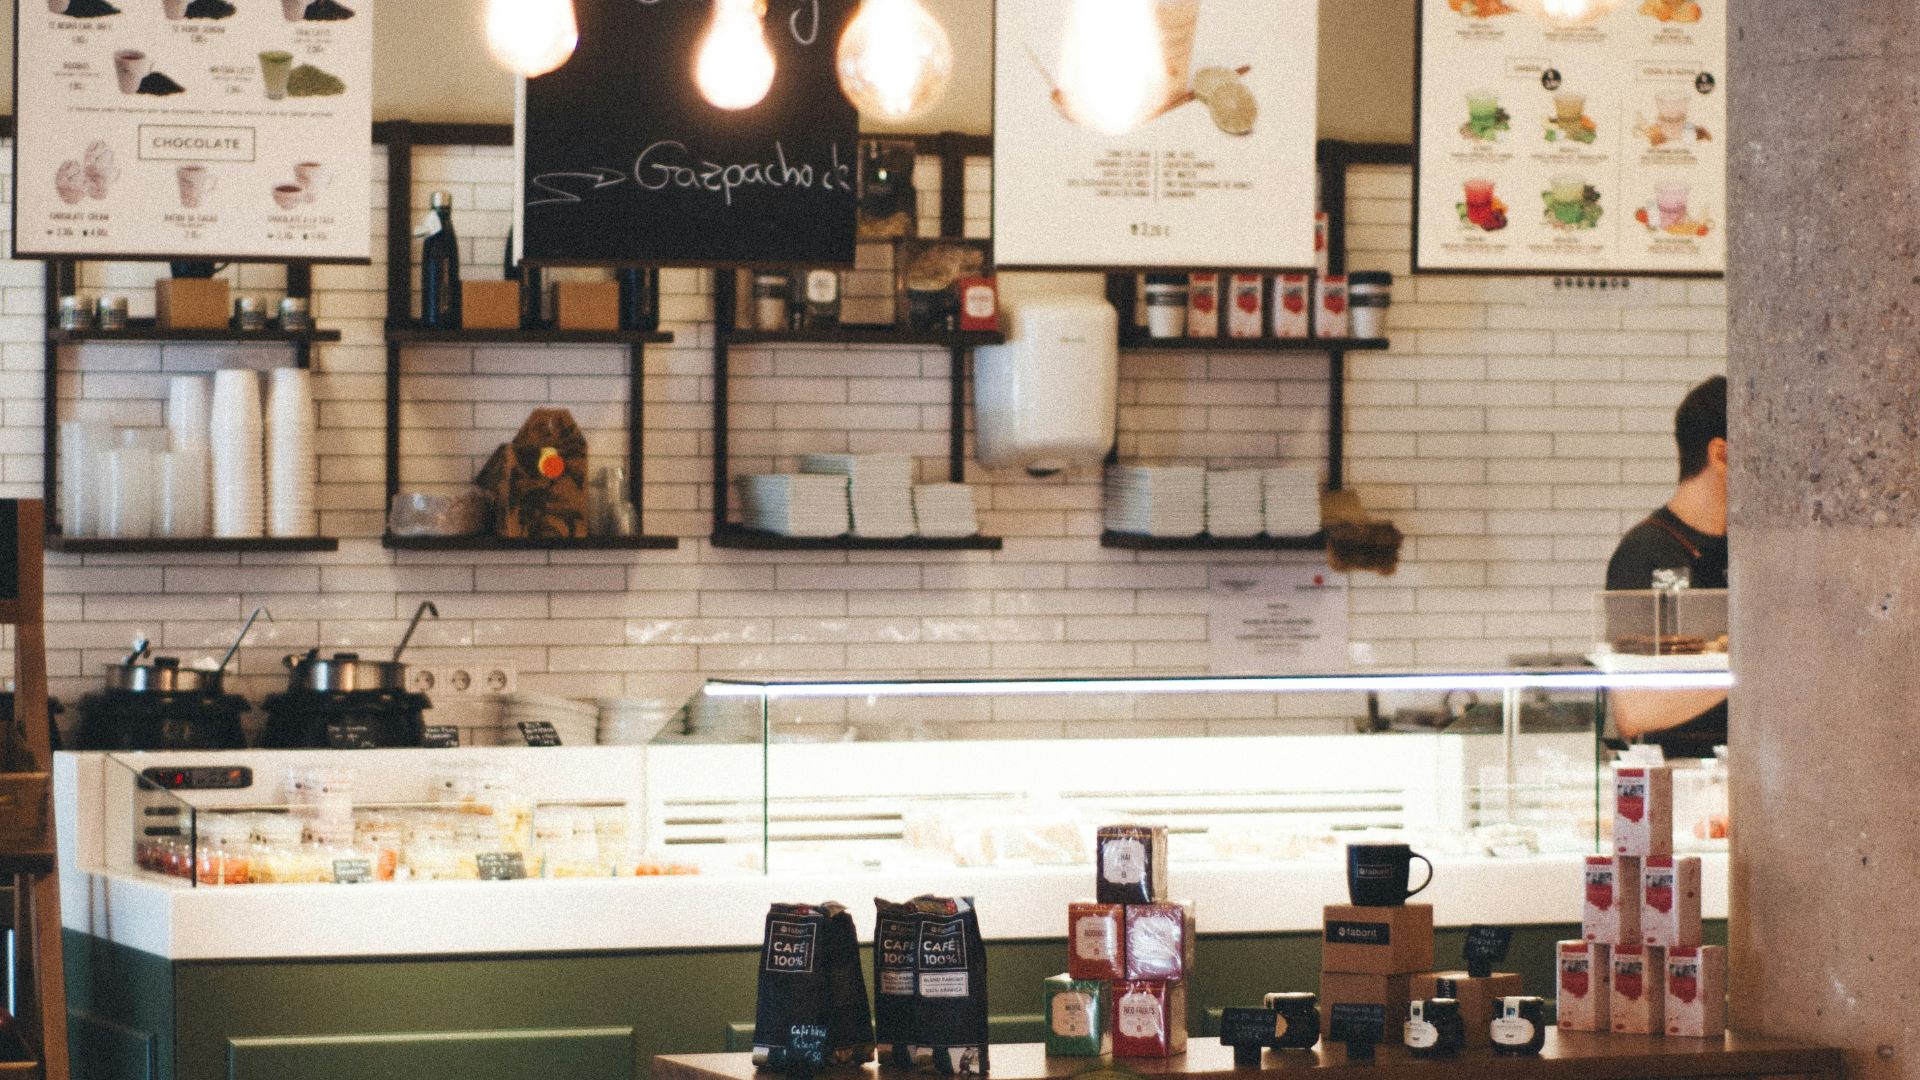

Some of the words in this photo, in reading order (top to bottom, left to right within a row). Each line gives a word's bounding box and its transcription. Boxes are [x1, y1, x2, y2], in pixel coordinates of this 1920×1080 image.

[152, 136, 241, 150] CHOCOLATE
[634, 140, 814, 207] Gazpacho
[1347, 926, 1378, 938] faborit
[773, 940, 806, 954] CAFÉ
[922, 937, 956, 952] CAFÉ
[773, 954, 804, 968] 100%
[924, 953, 957, 966] 100%
